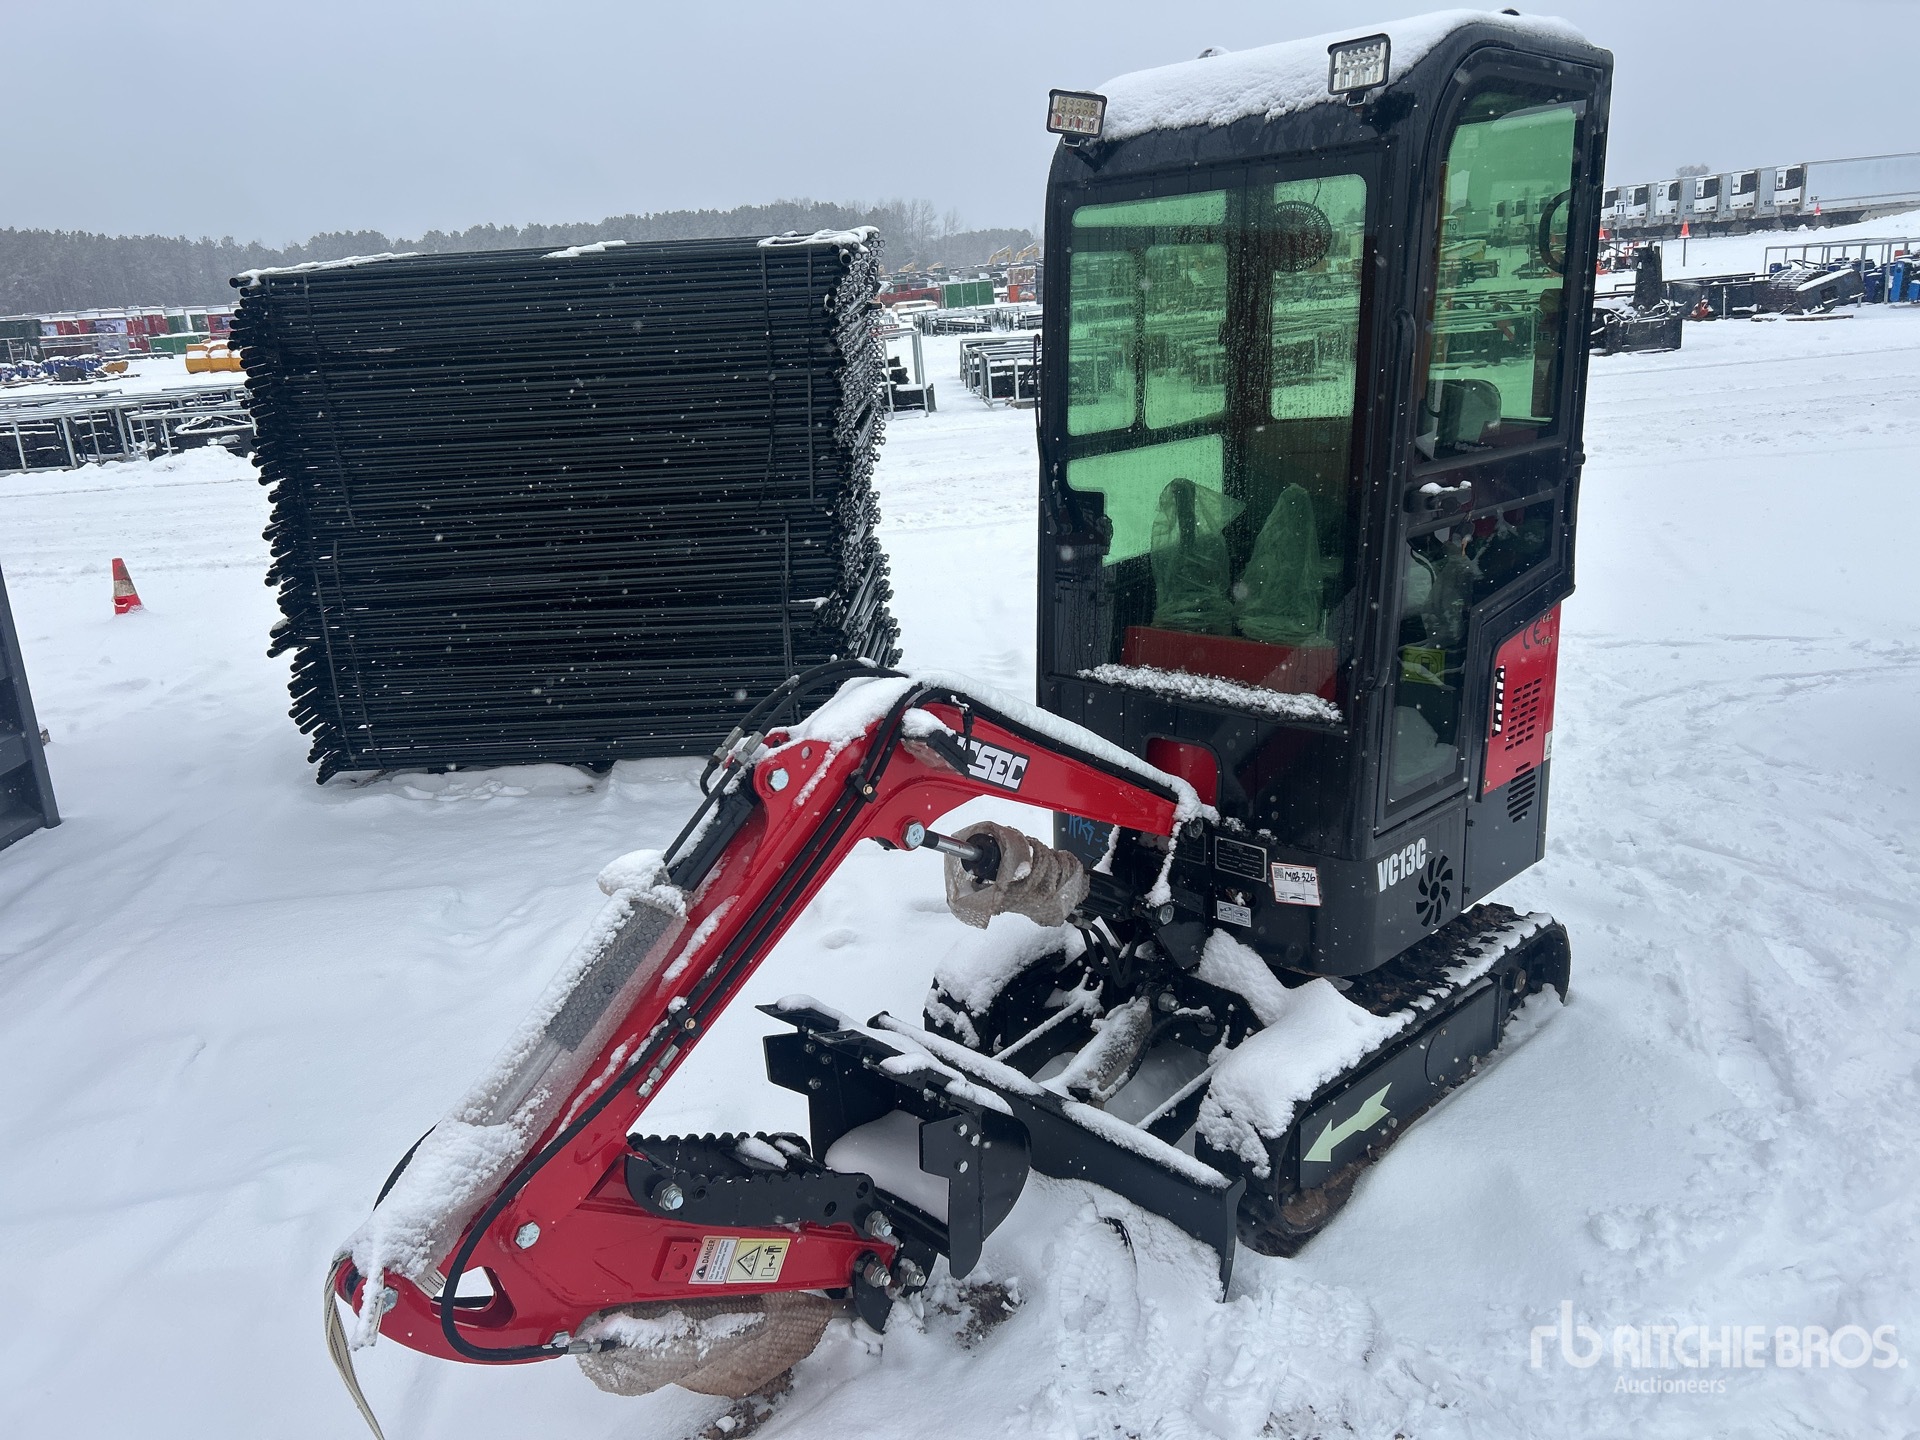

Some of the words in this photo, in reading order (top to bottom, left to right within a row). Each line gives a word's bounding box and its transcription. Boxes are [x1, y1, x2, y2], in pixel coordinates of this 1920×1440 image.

[1616, 204, 1625, 213] 11
[1377, 837, 1427, 893] VC13C
[702, 1240, 715, 1264] DANGER
